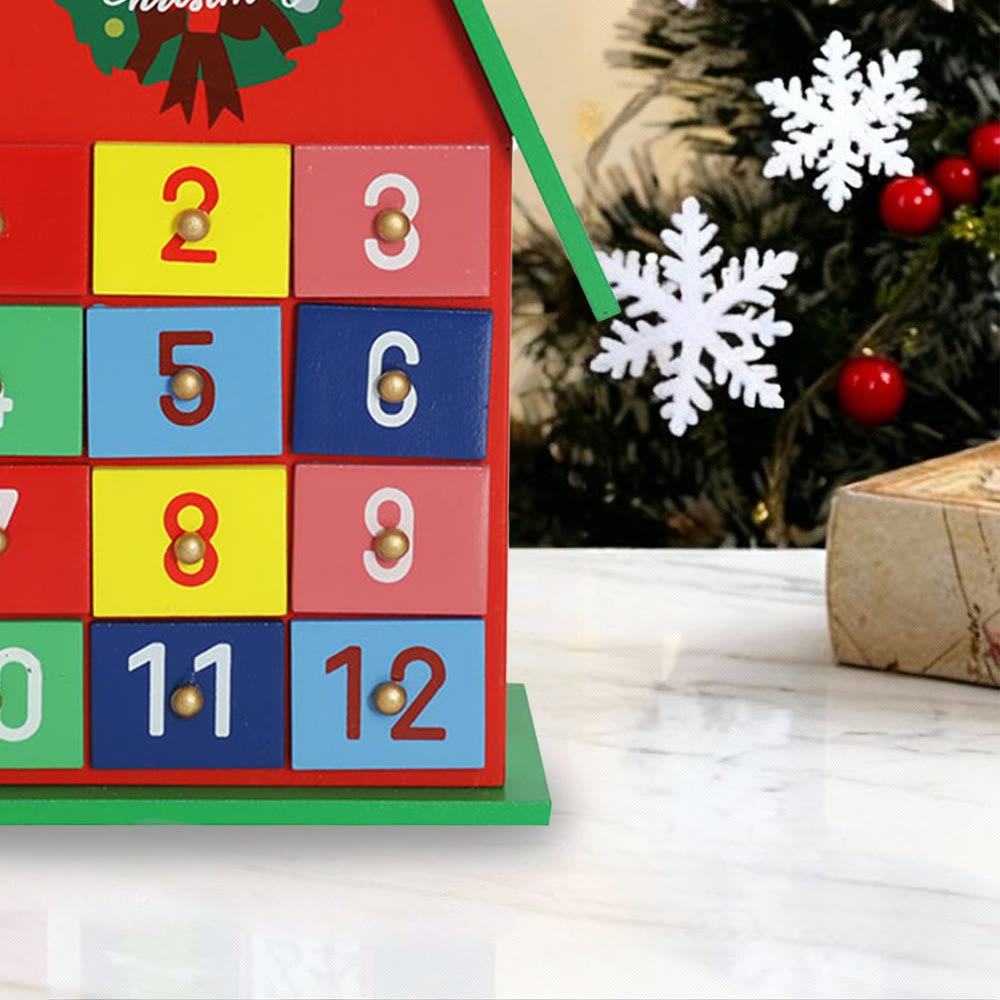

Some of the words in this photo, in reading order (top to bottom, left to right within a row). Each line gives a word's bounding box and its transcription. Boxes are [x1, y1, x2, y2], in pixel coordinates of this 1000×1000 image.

[161, 166, 219, 264] 2
[363, 173, 420, 270] 3
[158, 330, 216, 426] 5
[366, 330, 420, 427] 6
[163, 492, 219, 587] 8
[362, 487, 415, 583] 9
[127, 642, 232, 738] 11
[324, 645, 446, 741] 12
